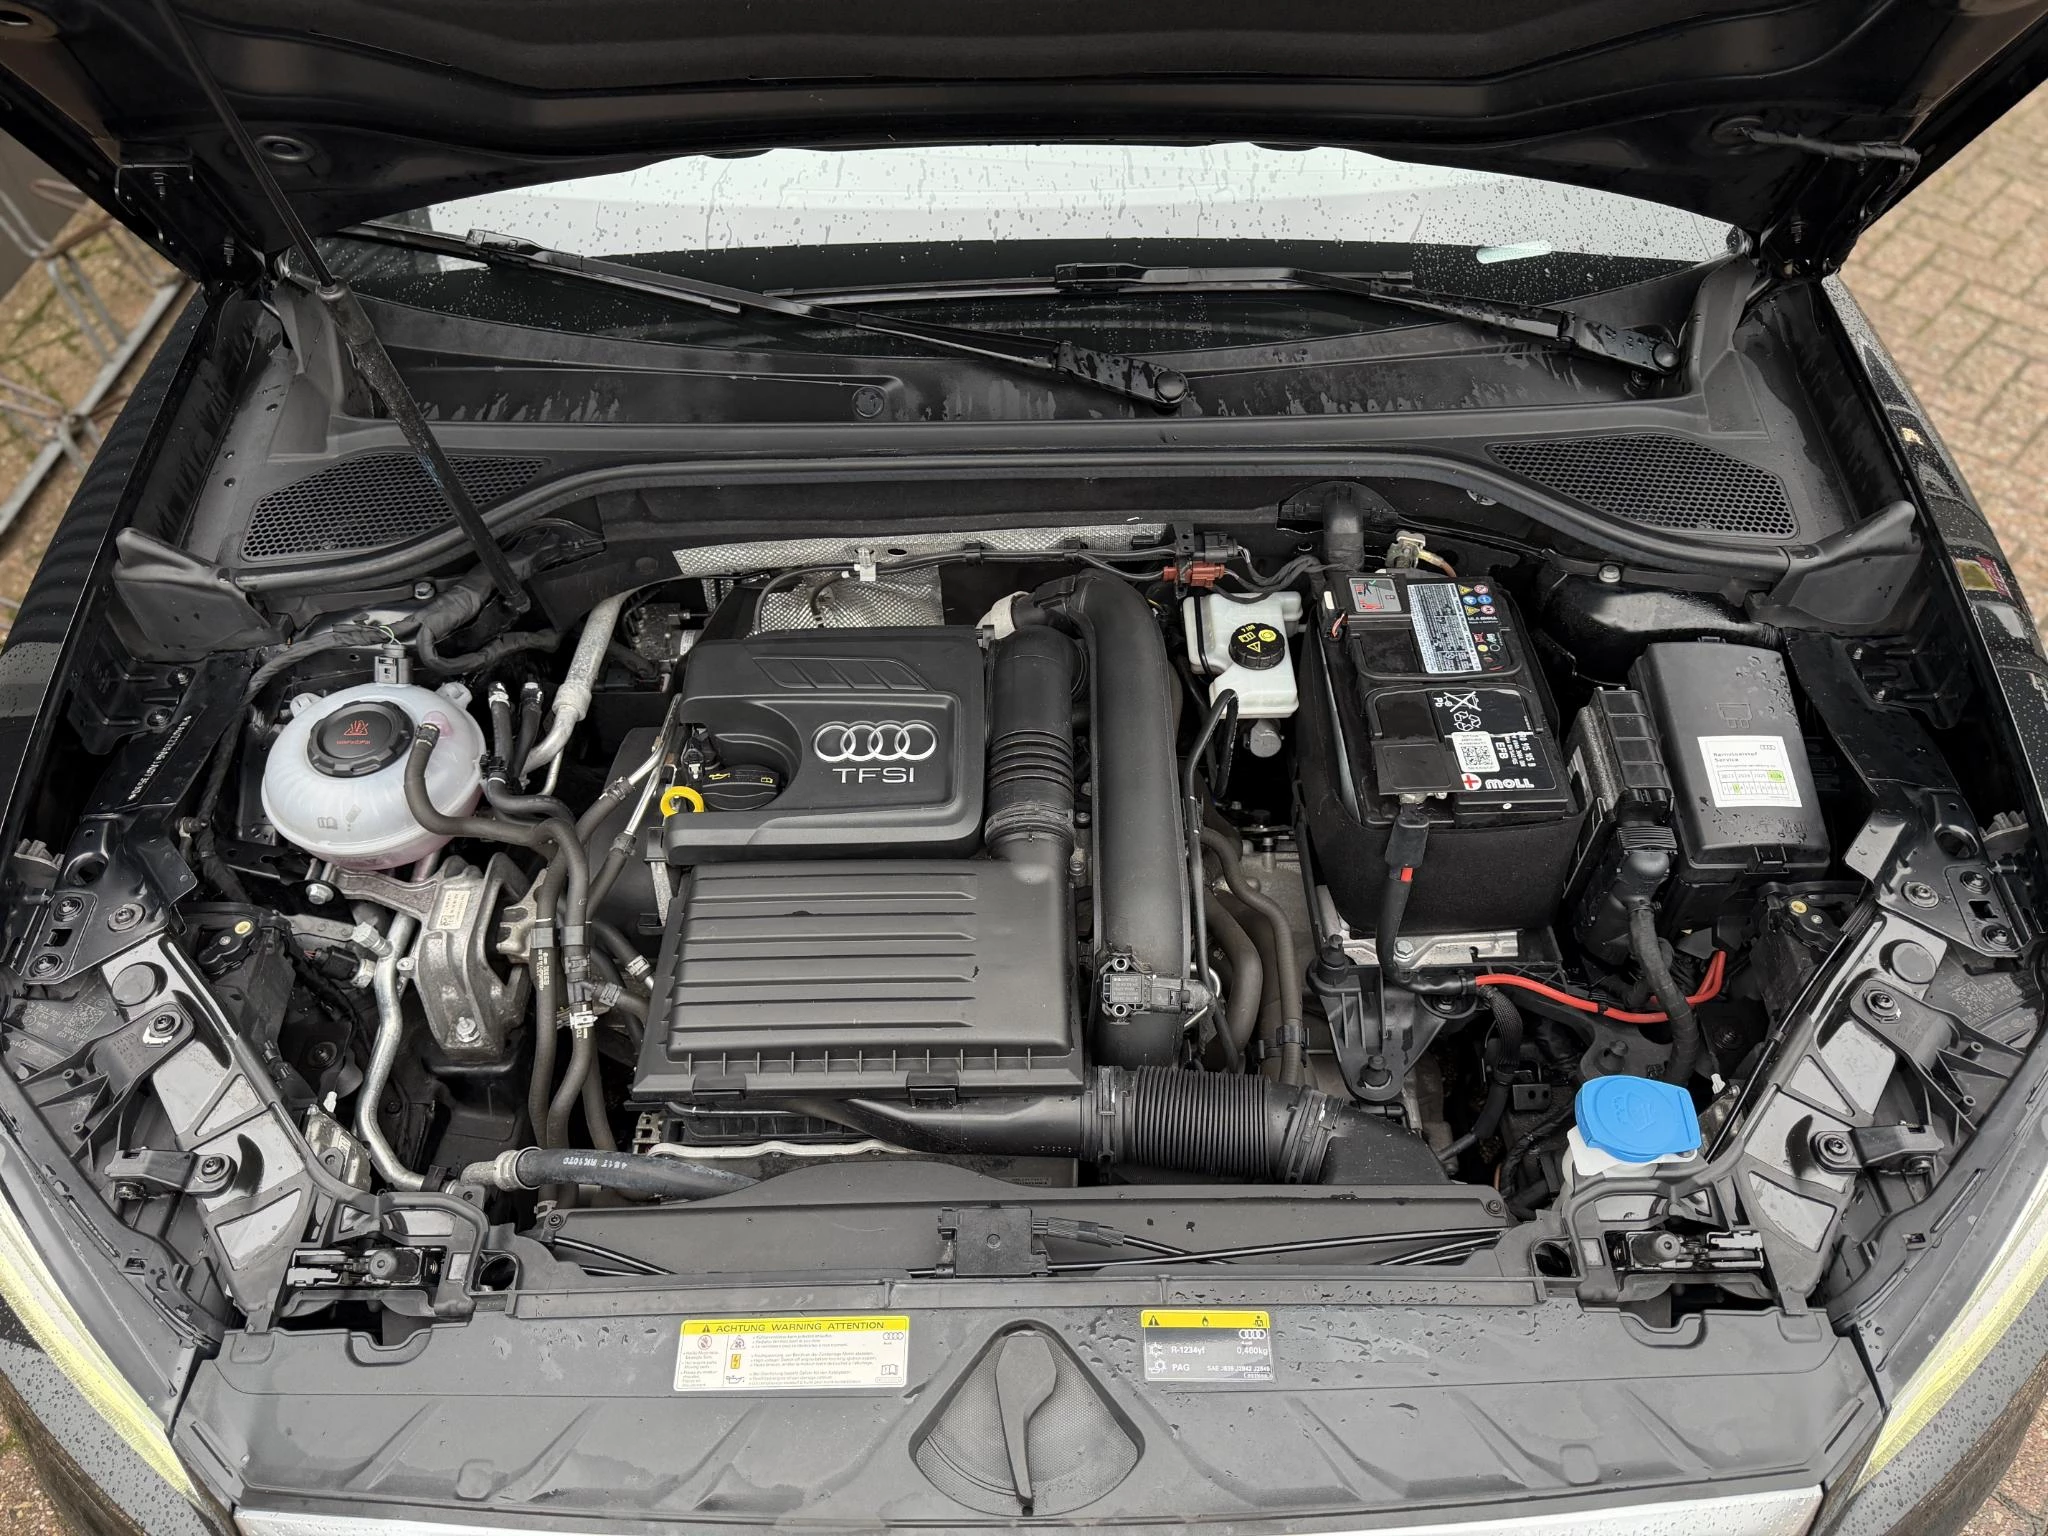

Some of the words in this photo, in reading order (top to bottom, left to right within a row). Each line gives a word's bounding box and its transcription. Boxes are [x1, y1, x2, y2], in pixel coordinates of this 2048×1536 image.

[1495, 742, 1509, 759] EFB
[832, 767, 915, 784] TFSI
[716, 1323, 766, 1333] ACHTUNG
[771, 1322, 822, 1332] WARNING
[827, 1321, 885, 1330] ATTENTION
[1171, 1346, 1206, 1355] R-1234yf
[1172, 1363, 1190, 1372] PAG
